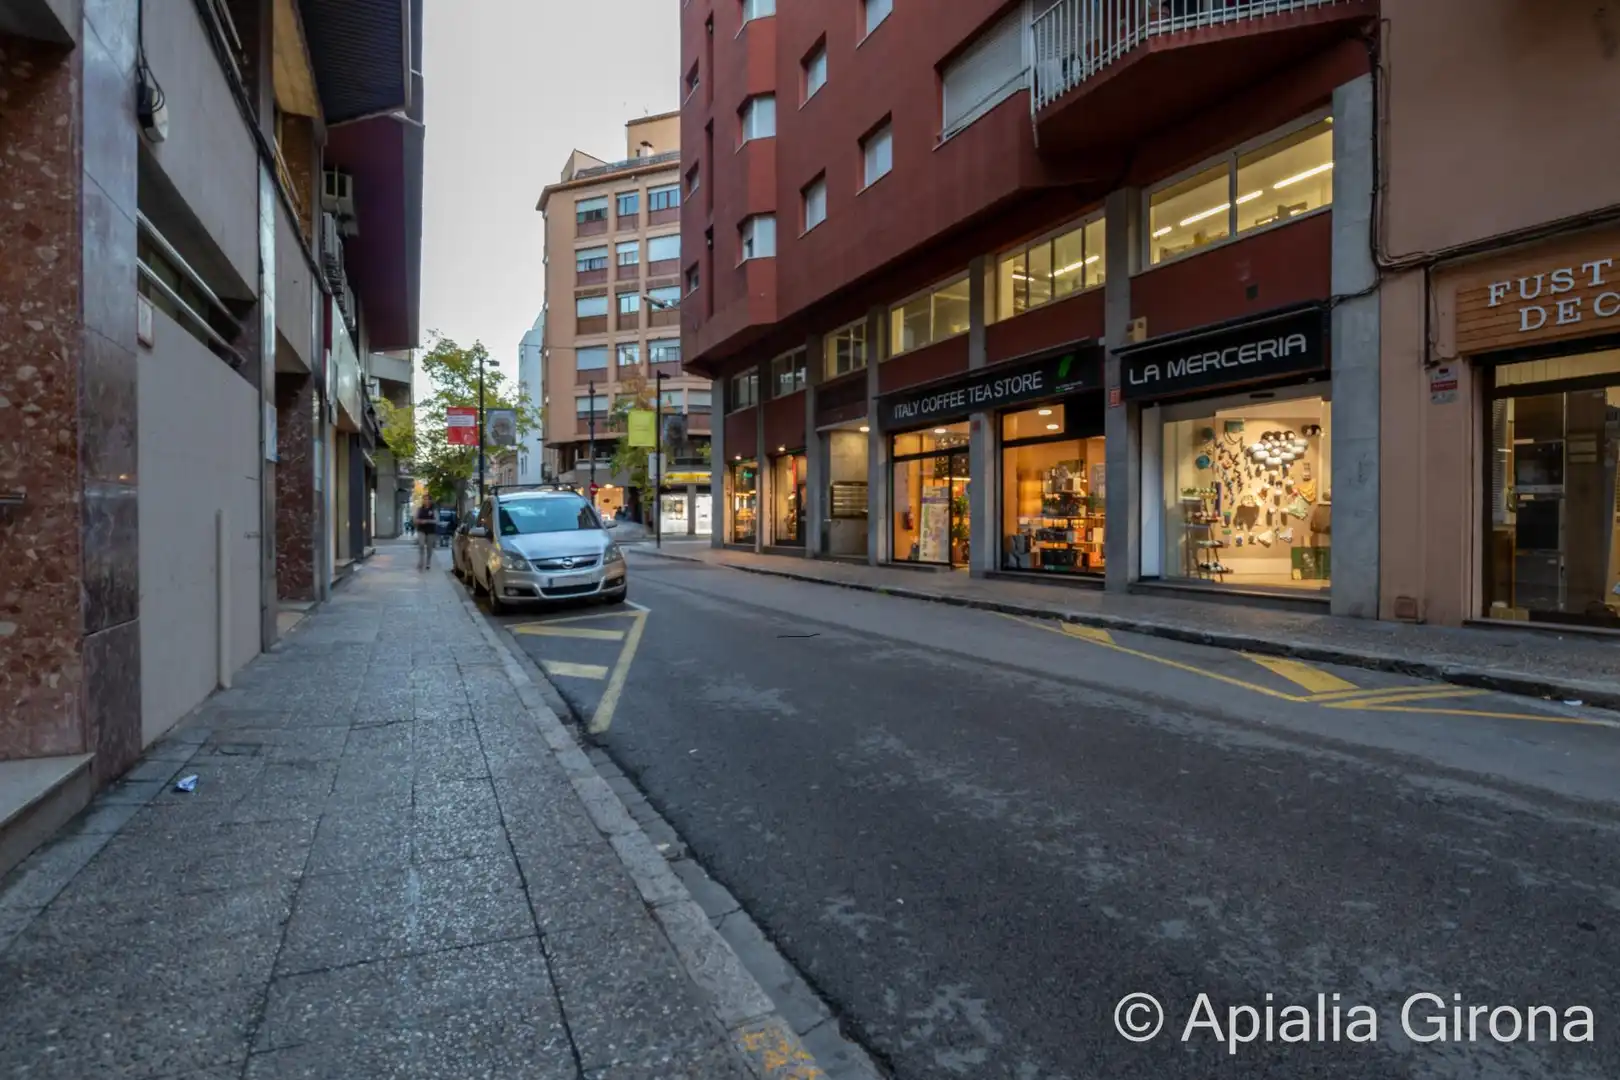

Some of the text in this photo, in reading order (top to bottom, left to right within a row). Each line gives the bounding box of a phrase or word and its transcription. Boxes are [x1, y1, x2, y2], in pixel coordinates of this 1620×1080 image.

[1487, 258, 1613, 308] FUST
[1518, 291, 1620, 332] DEC
[1129, 333, 1307, 385] LA MERCERIA
[894, 400, 923, 419] ITALY
[921, 391, 966, 413] COFFEE
[967, 383, 993, 404] TEA
[993, 370, 1044, 398] STORE
